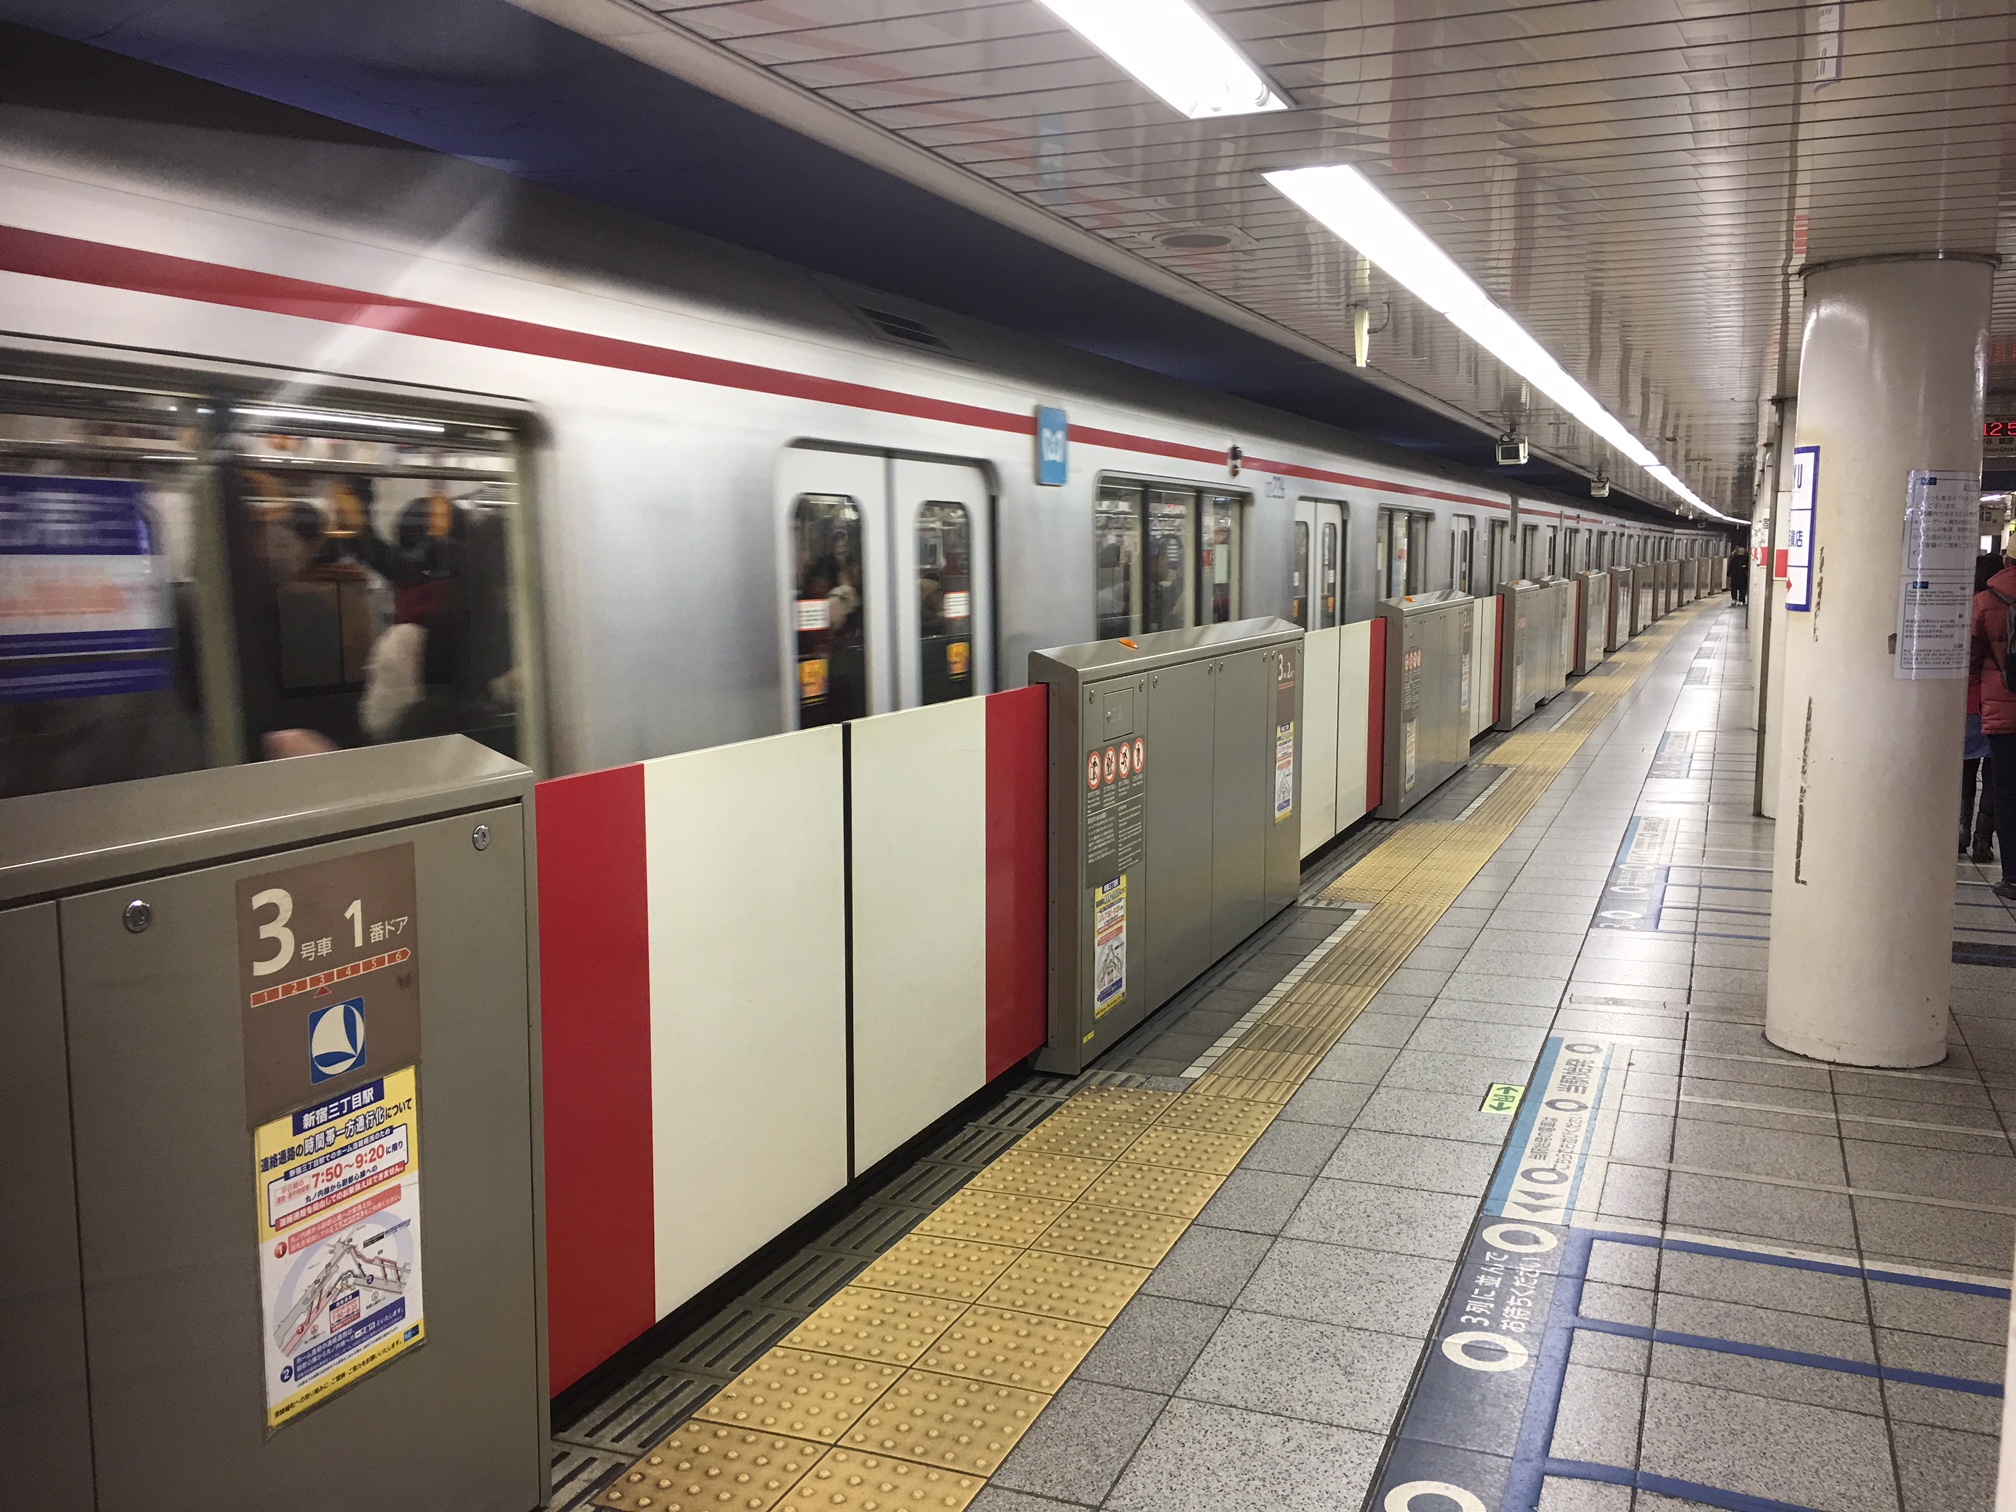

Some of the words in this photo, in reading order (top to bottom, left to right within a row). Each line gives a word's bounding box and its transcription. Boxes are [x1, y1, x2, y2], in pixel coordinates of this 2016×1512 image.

[1278, 653, 1284, 681] 3
[251, 887, 333, 977] 3号車
[343, 898, 409, 948] 1番ドア
[262, 991, 269, 1001] 1
[290, 982, 298, 994] 2
[318, 974, 326, 985] 3
[345, 965, 353, 977] 4
[370, 958, 378, 969] 5
[395, 950, 403, 961] 6
[260, 1096, 412, 1173] 連絡通路の時間帯一方通行化について
[302, 1085, 374, 1130] 新宿三丁目駅
[1460, 1250, 1509, 1327] 3列に並んで
[1499, 1256, 1542, 1334] お待ちください
